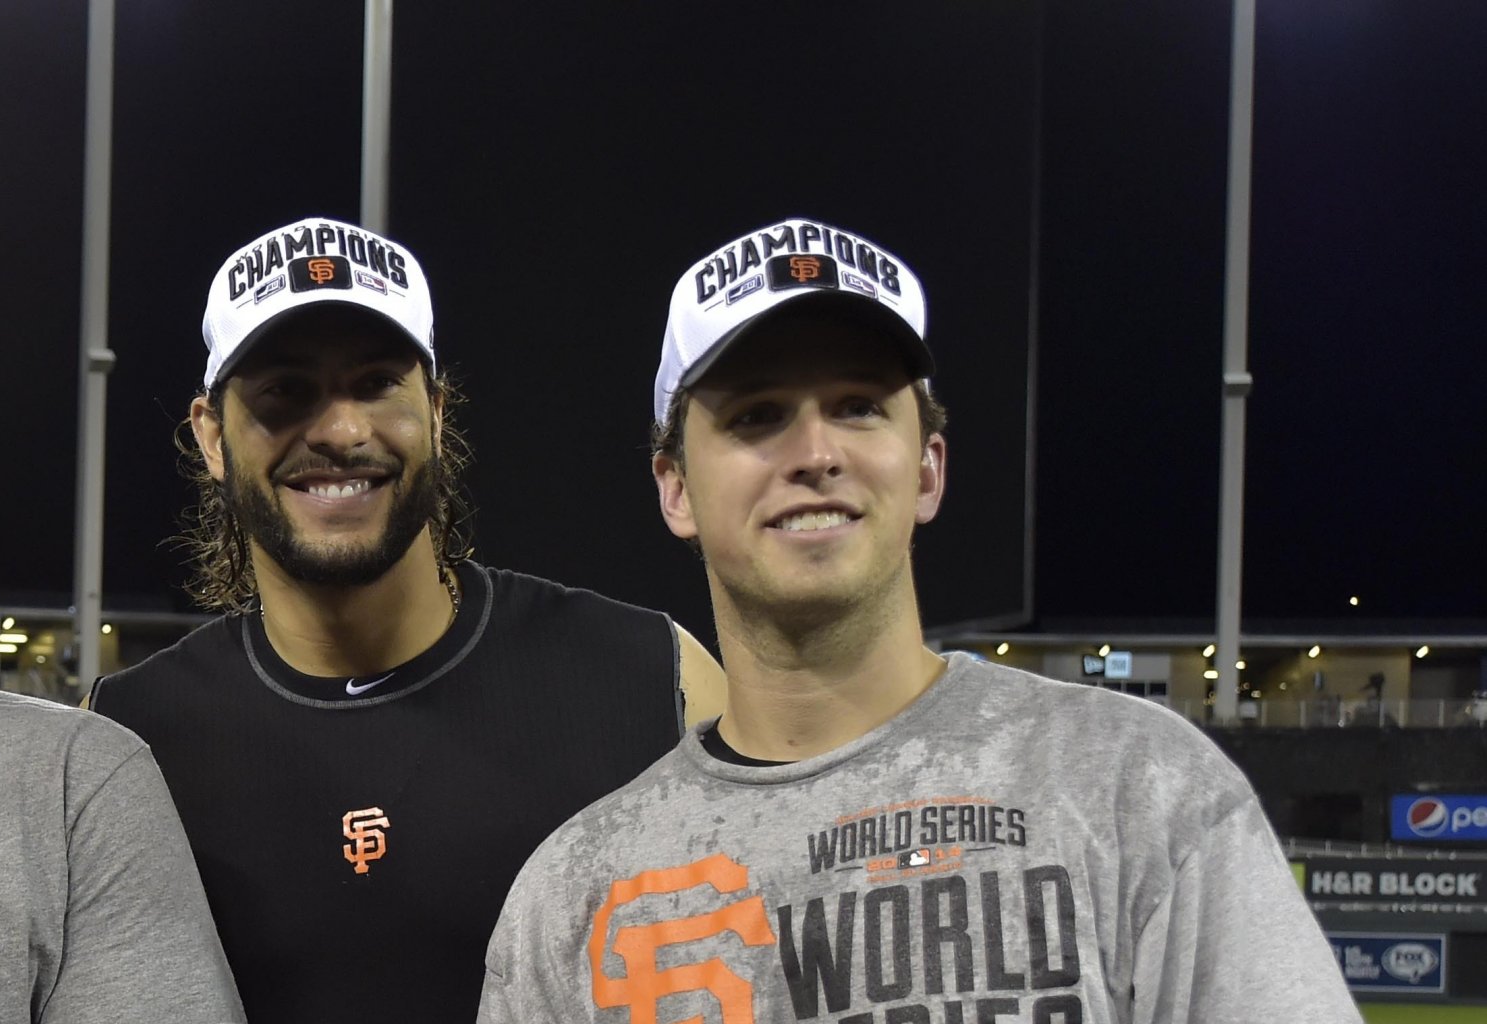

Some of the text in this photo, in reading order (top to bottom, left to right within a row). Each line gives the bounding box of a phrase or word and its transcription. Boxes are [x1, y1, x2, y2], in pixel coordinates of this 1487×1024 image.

[228, 226, 408, 301] CHAMPIONS
[694, 224, 901, 304] CHAMPIONS
[807, 810, 912, 875] WORLD
[919, 804, 1026, 848] SERIES
[1312, 871, 1478, 896] H&R BLOCK
[776, 864, 1081, 1020] WORLD
